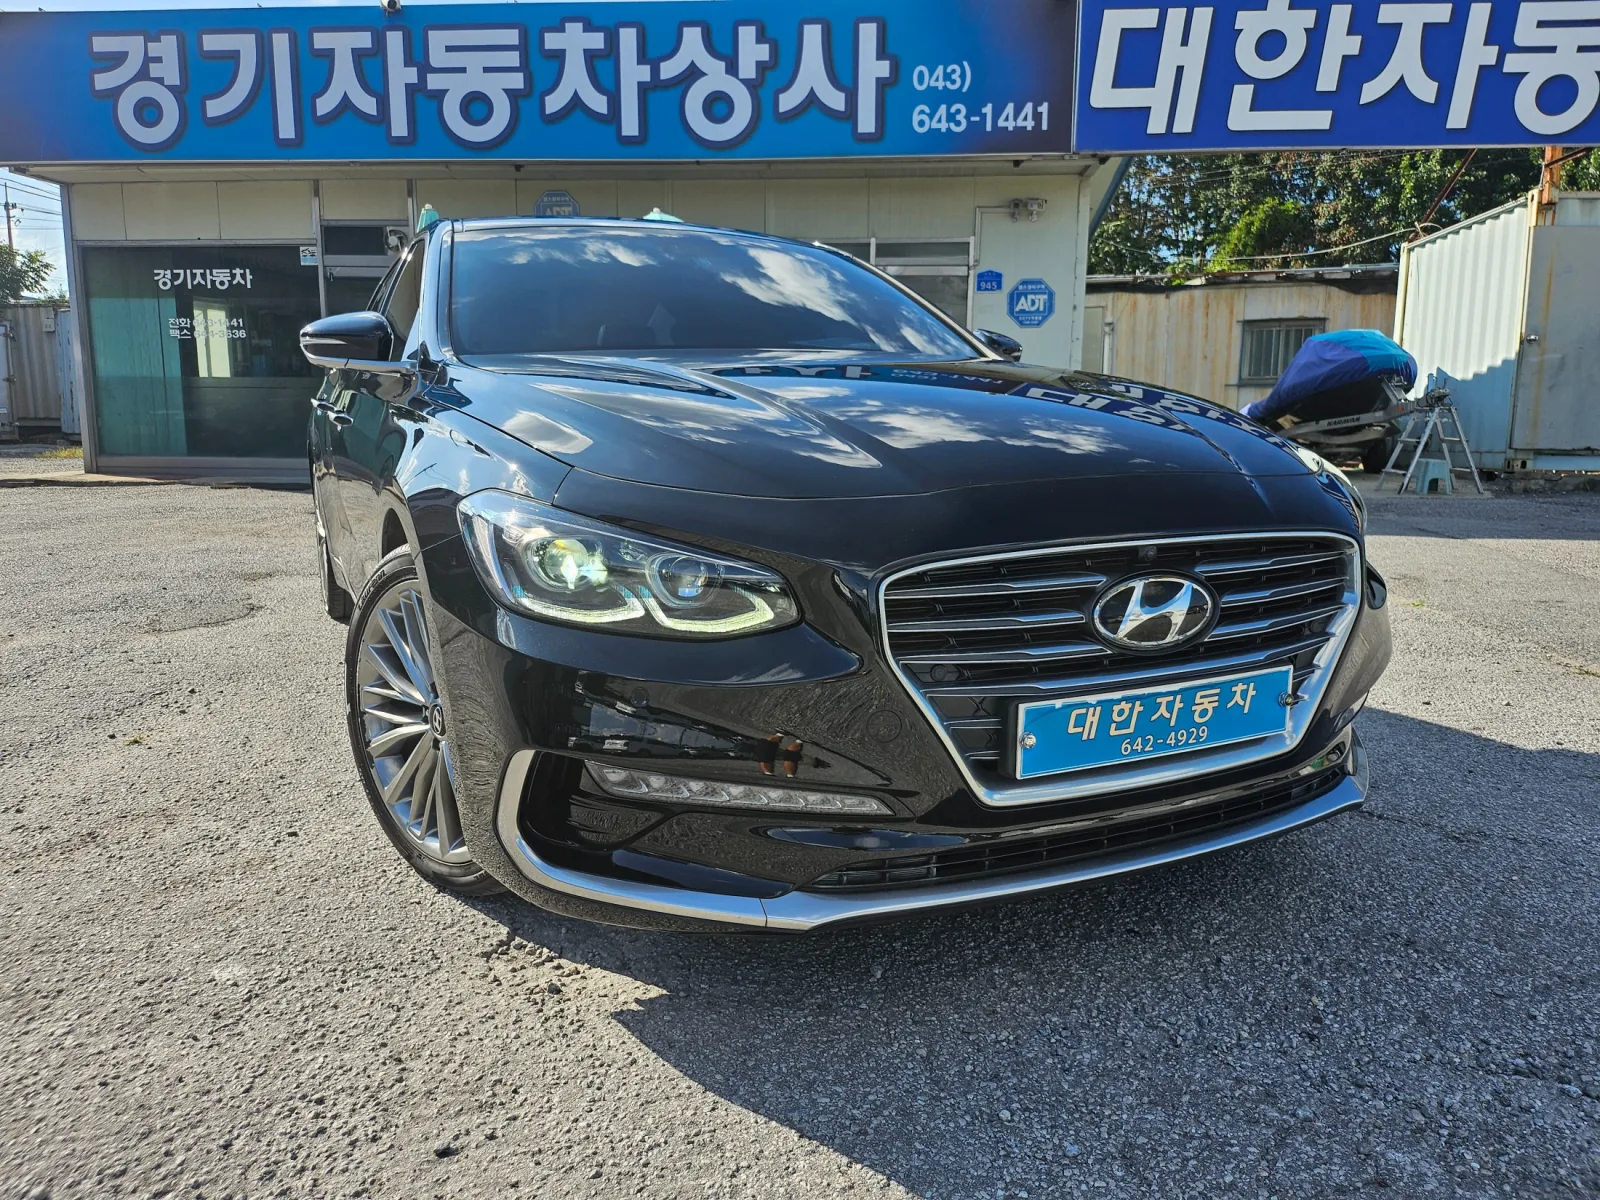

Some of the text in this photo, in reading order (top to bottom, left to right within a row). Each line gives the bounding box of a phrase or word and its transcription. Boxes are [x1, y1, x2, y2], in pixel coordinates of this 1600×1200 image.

[91, 22, 891, 144] 경기자동차상사
[912, 60, 972, 93] 043)
[1089, 0, 1600, 136] 대한자동
[912, 102, 1049, 134] 643-1441
[153, 267, 253, 290] 경기자동차
[980, 282, 998, 291] 945
[1015, 294, 1048, 312] ADT
[168, 318, 244, 328] 전화 643-1441
[1120, 725, 1209, 756] 642-4929
